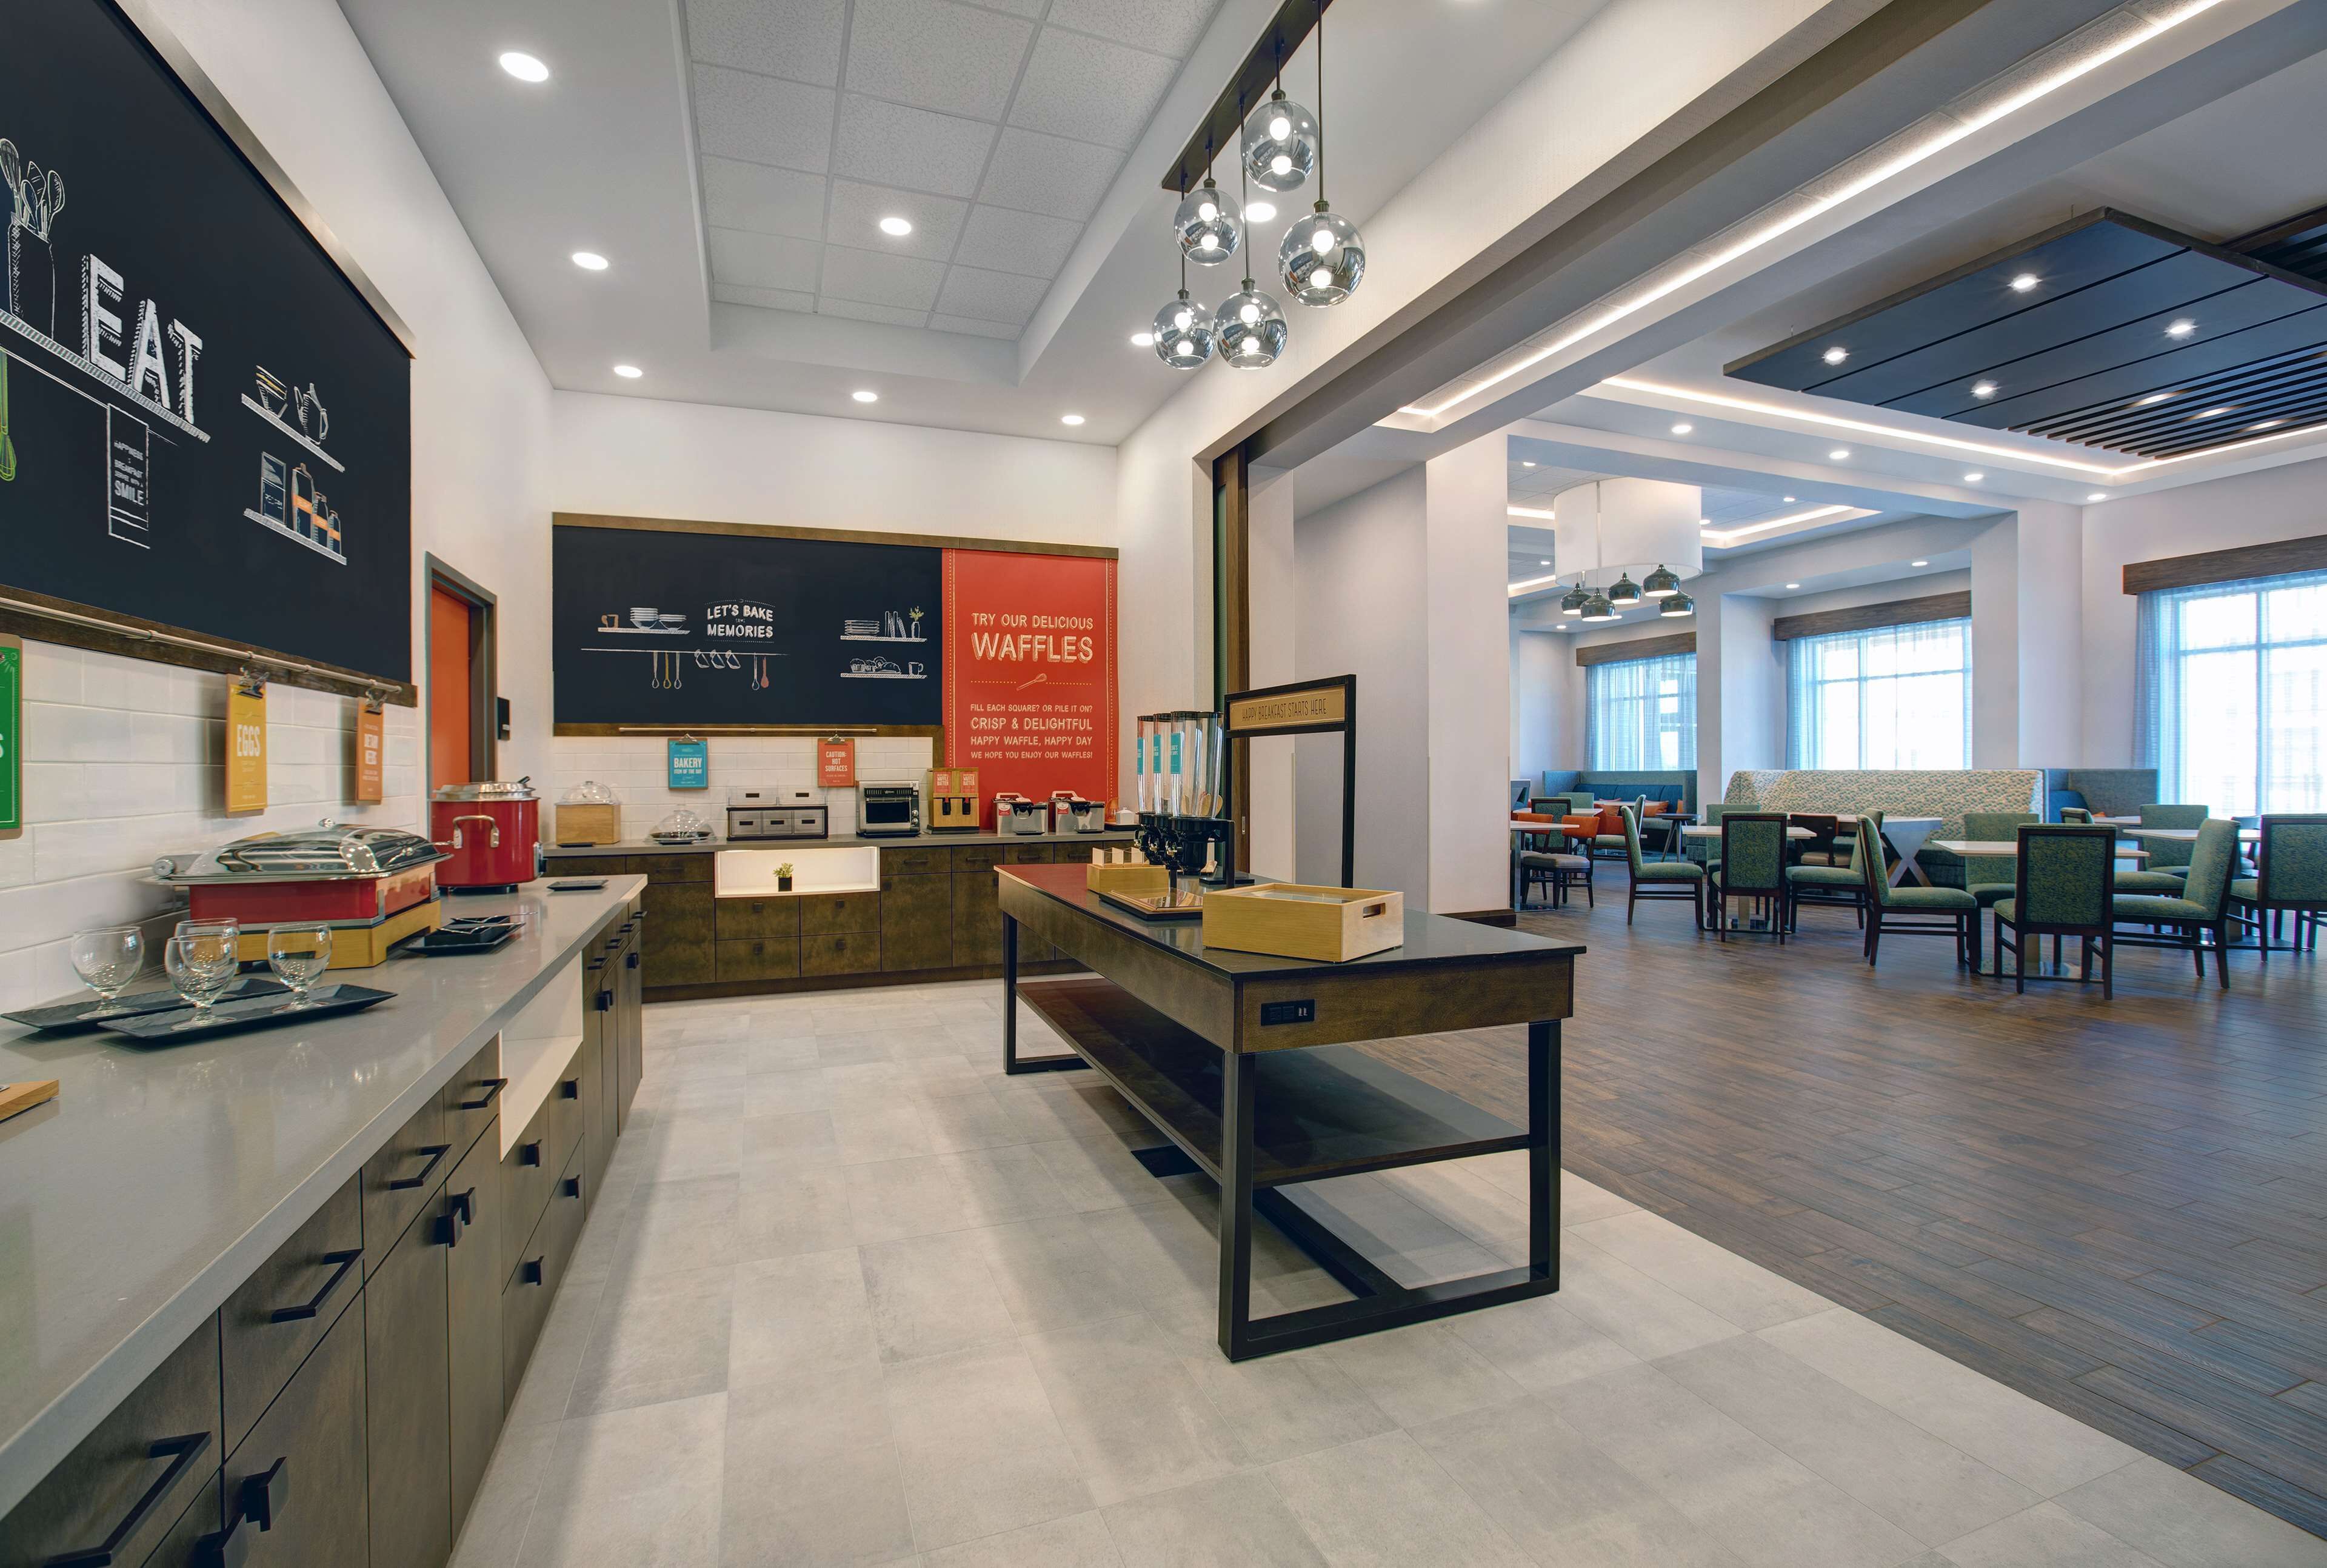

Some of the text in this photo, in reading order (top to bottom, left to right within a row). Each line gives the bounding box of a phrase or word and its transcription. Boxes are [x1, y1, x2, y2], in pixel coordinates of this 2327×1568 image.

[82, 253, 203, 424] EAT
[114, 480, 144, 506] SMILE
[707, 604, 773, 622] LET'S BAKE
[971, 613, 1093, 630] TRY OUR DELICIOUS
[707, 624, 773, 638] MEMORIES
[971, 632, 1093, 664] WAFFLES
[1008, 704, 1040, 713] SQUARE?
[1242, 698, 1327, 721] HAPPY BREAKFAST STARTS HERE
[970, 717, 1093, 731] CRISP & DELIGHTFUL
[236, 724, 261, 757] EGGS
[970, 736, 1092, 747] HAPPY WAFFLE, HAPPY DAY
[674, 758, 702, 768] BAKERY
